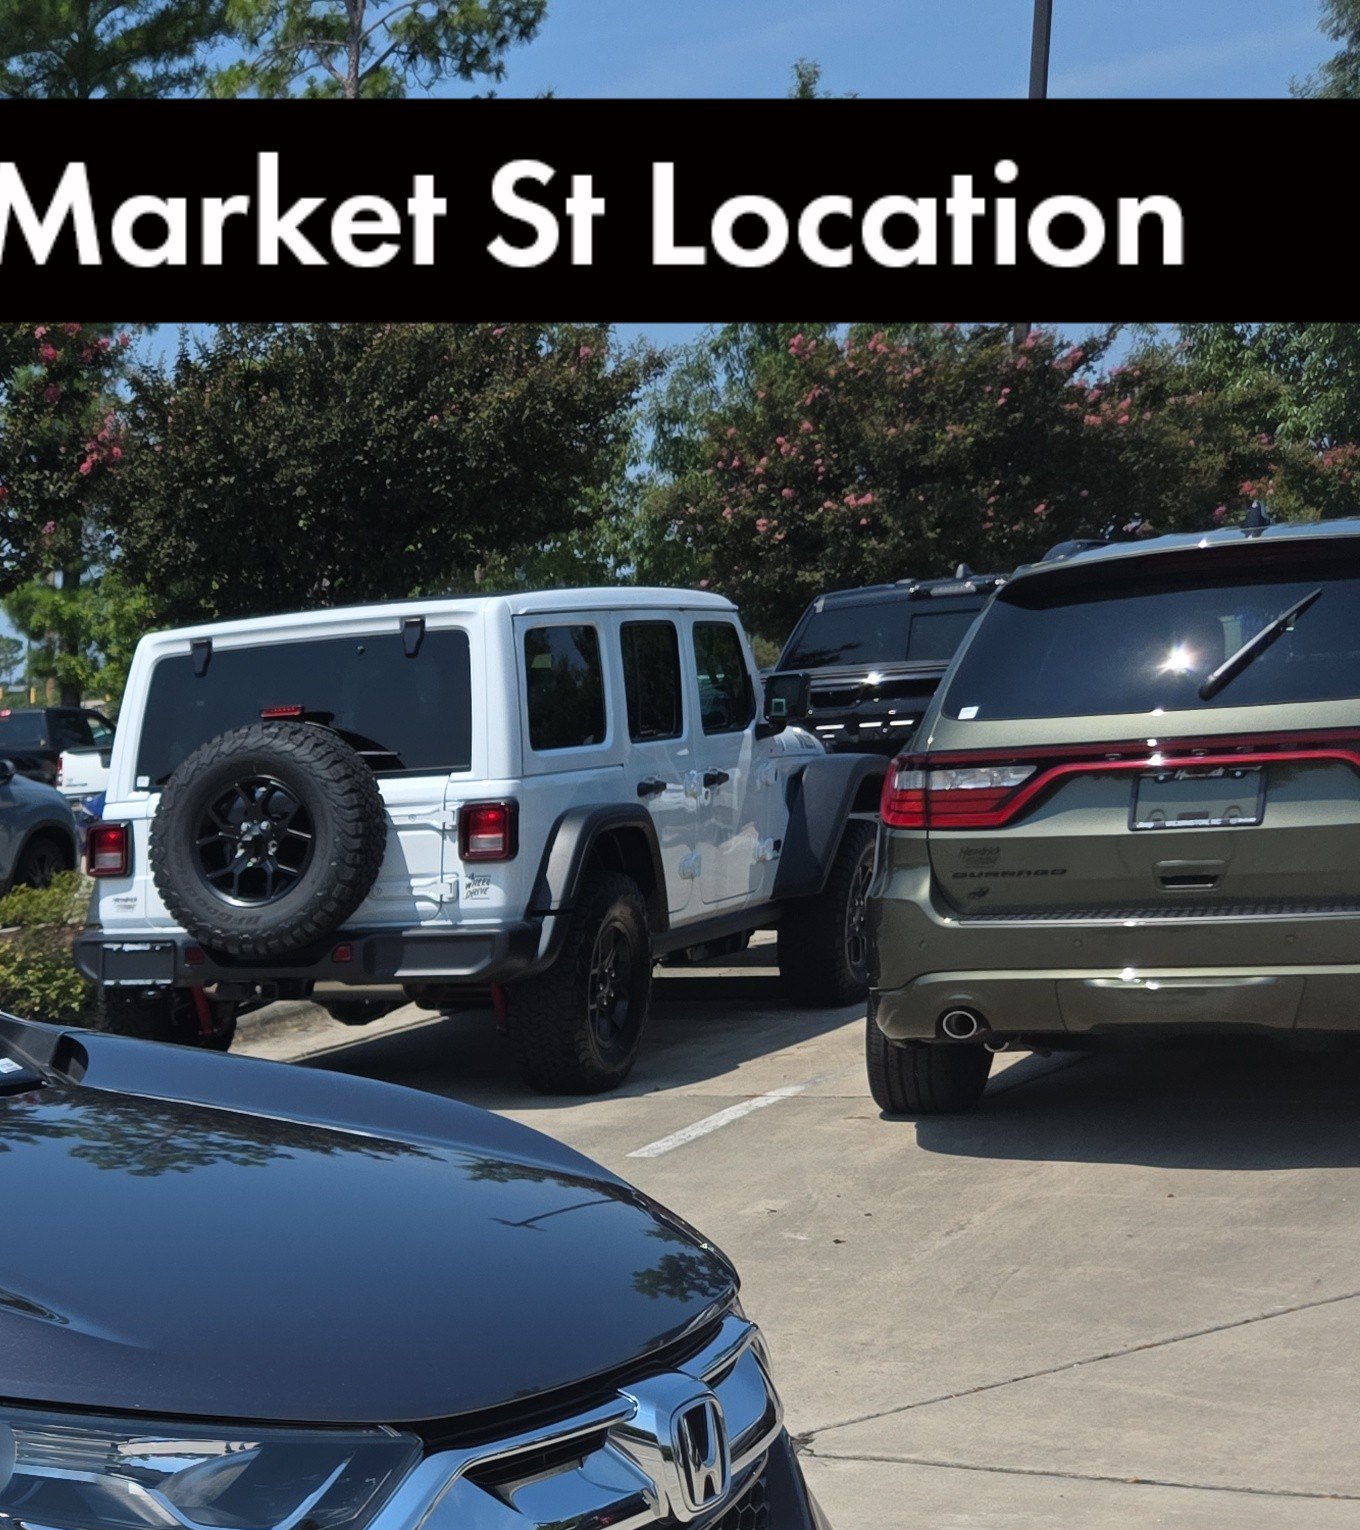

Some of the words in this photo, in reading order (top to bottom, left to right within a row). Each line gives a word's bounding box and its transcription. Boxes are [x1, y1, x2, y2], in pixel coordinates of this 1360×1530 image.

[951, 868, 1068, 879] DURANGO
[464, 878, 492, 890] WHEEL
[464, 886, 490, 900] DRIVE
